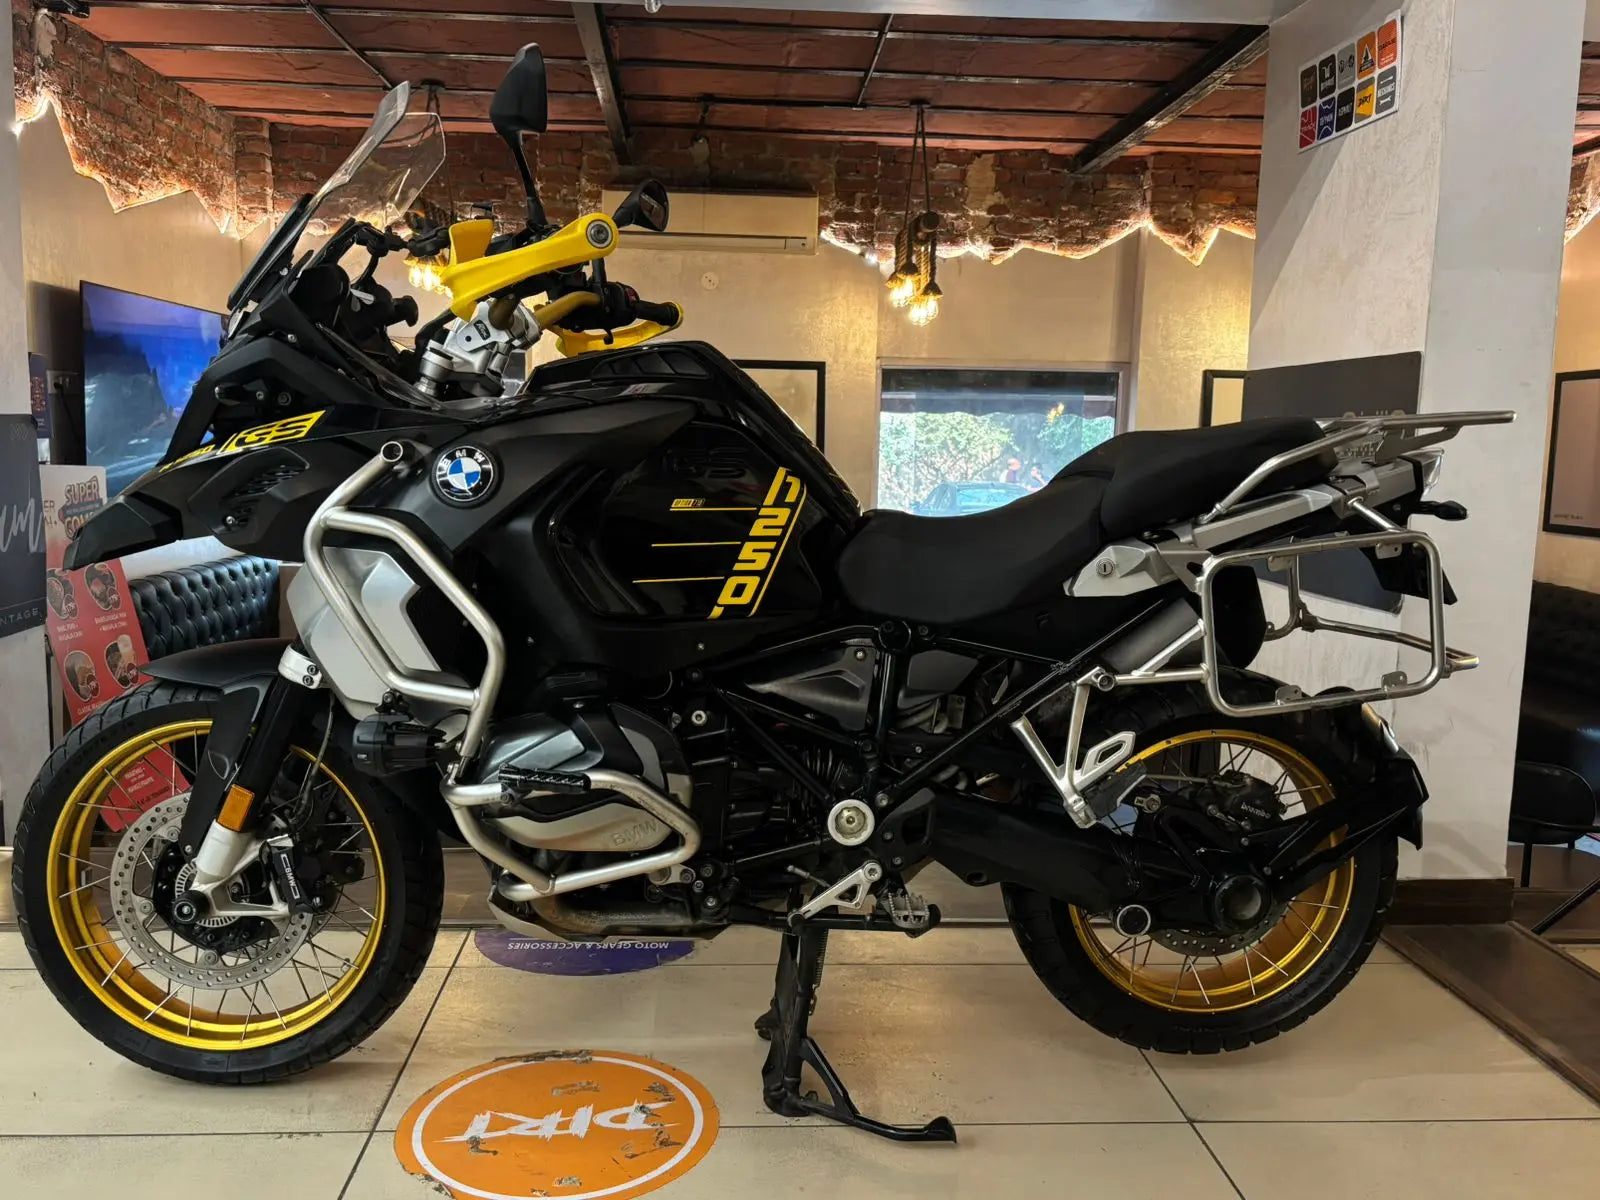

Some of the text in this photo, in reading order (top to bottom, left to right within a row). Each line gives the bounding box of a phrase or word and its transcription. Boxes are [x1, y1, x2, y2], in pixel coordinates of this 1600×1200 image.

[441, 448, 486, 467] BMW
[65, 480, 98, 504] SUPER
[717, 474, 801, 605] 1250
[1241, 802, 1271, 819] brembo
[610, 818, 659, 847] BMW
[507, 942, 582, 950] ACCESSORIES
[597, 941, 633, 950] GEARS
[634, 941, 670, 950] MOTO
[432, 1100, 681, 1141] DIRT
